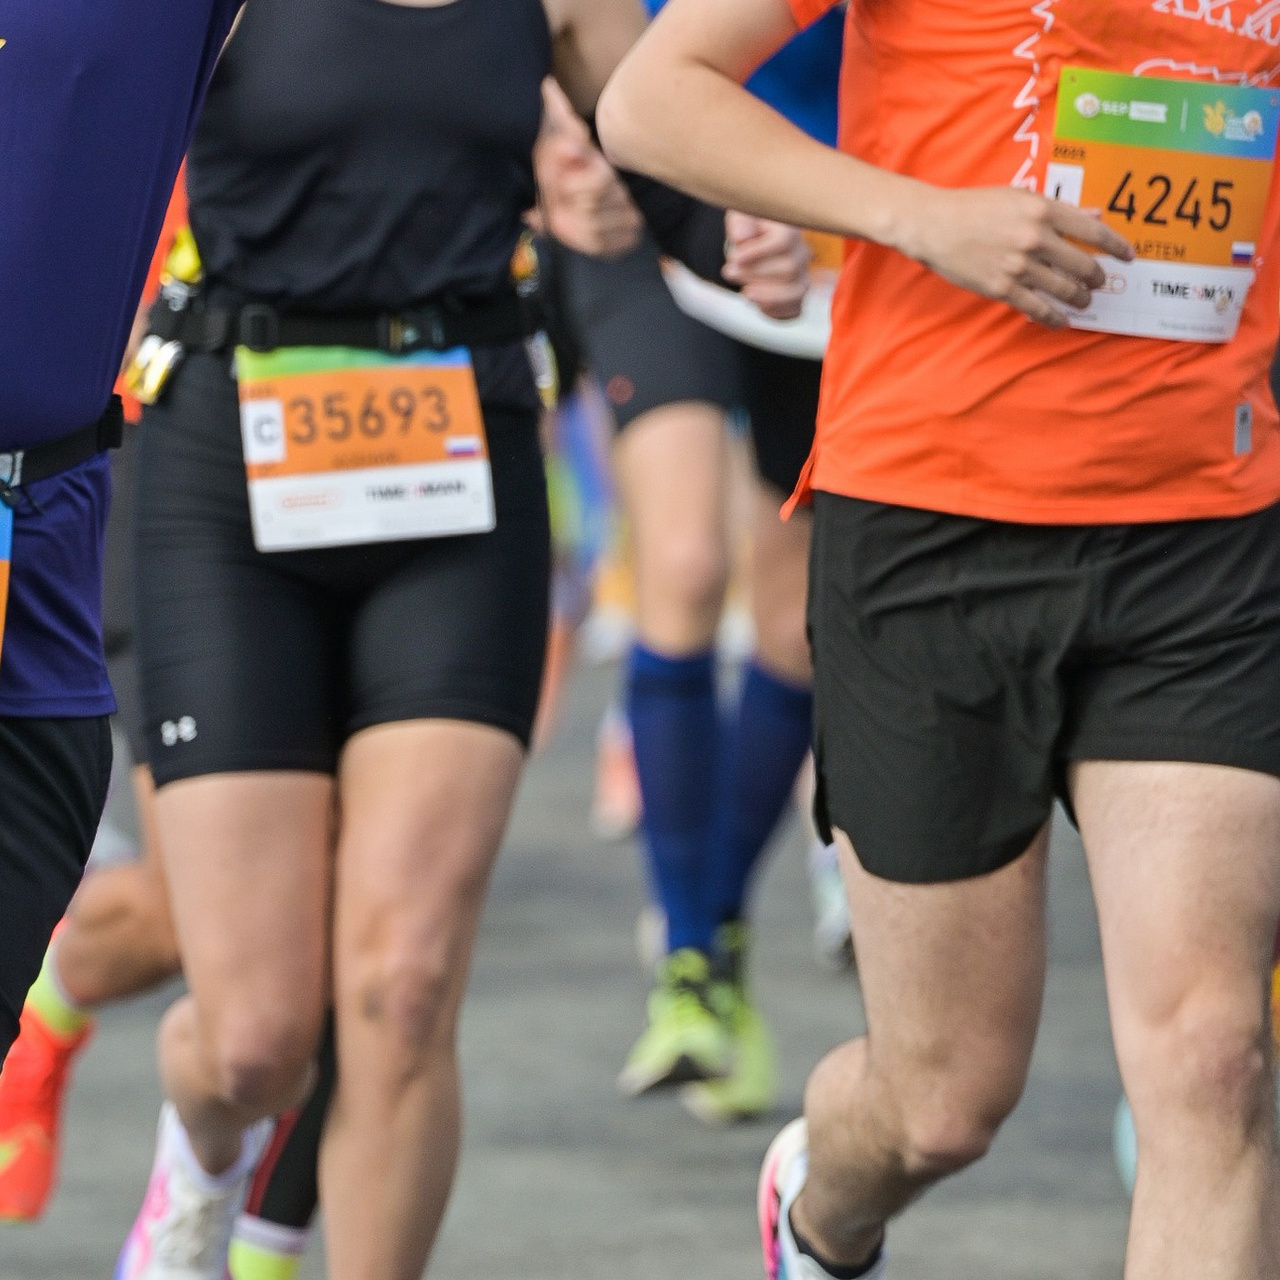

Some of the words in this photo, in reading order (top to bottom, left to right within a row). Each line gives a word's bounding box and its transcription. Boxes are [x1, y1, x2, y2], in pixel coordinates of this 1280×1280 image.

[1108, 171, 1234, 231] 4245
[254, 416, 277, 445] C
[289, 385, 450, 445] 35693
